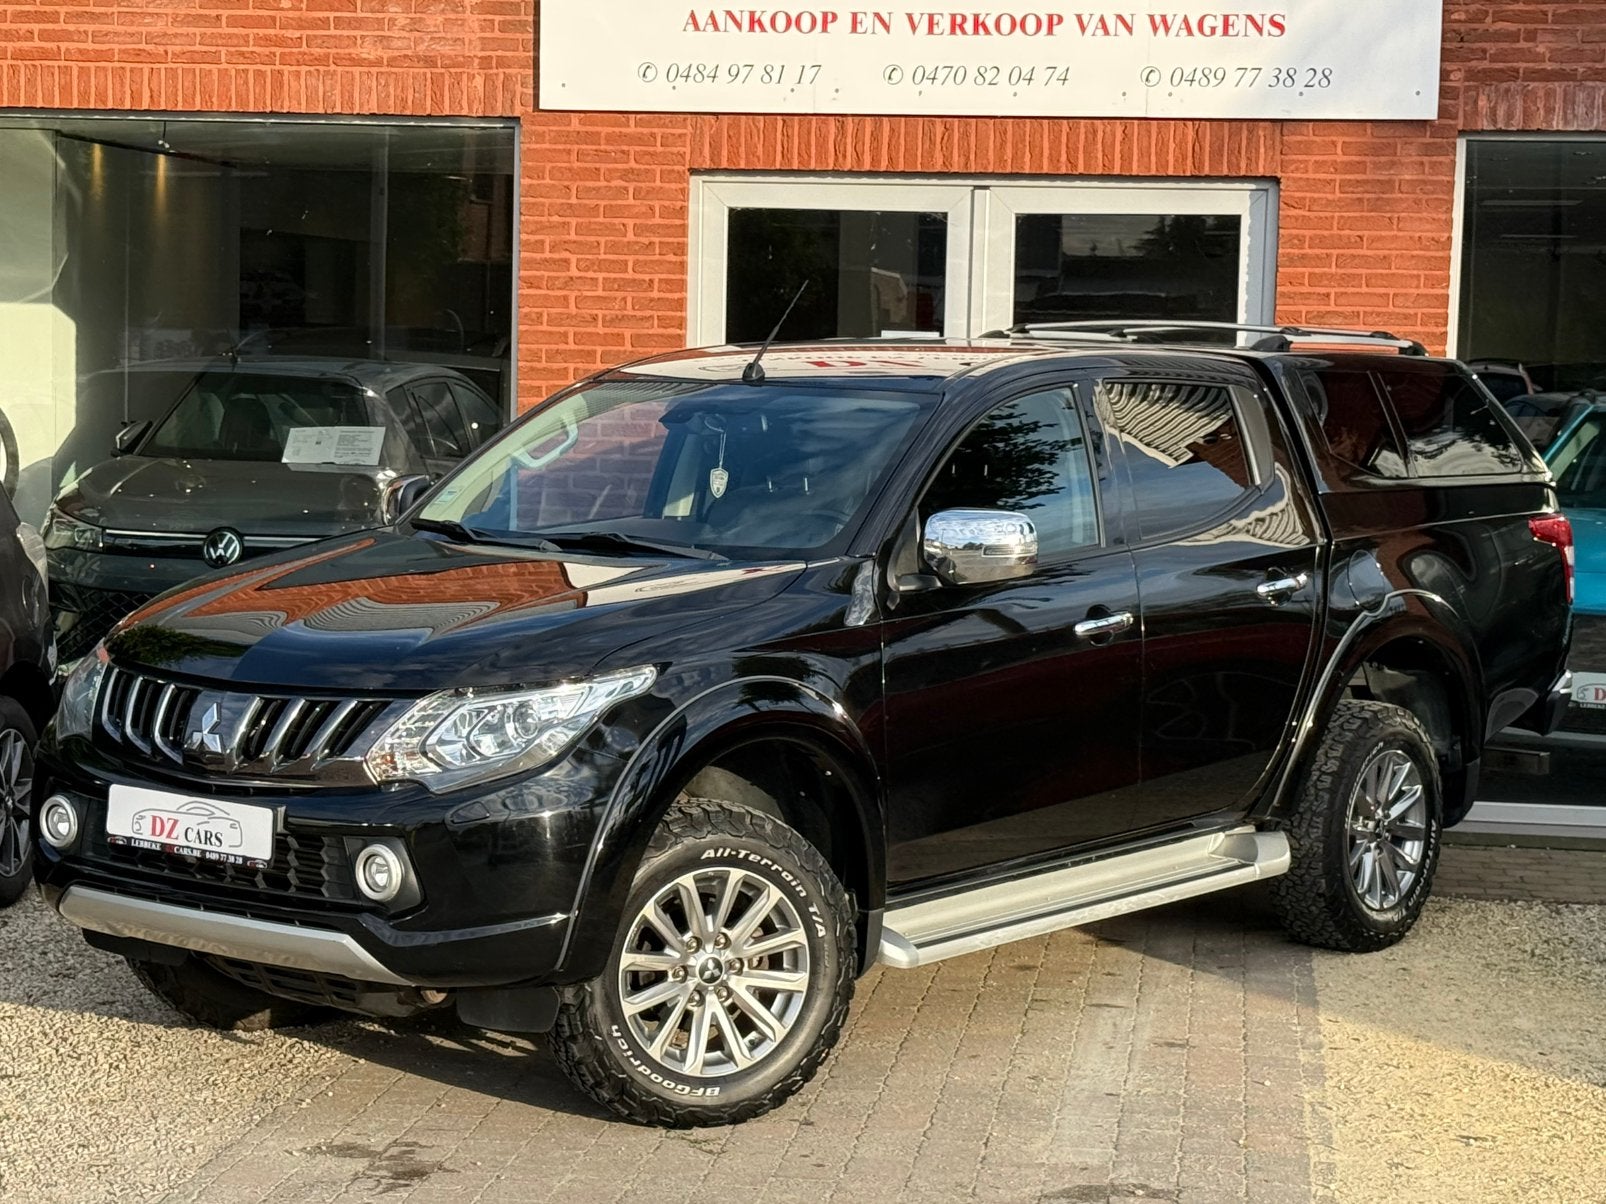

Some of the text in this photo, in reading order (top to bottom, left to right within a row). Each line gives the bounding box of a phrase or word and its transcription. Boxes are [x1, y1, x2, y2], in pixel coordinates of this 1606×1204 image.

[682, 9, 1287, 38] AANKOOP EN VERKOOP VAN WAGENS
[665, 62, 822, 85] 0484 97 81 17
[911, 64, 1070, 87] 0470 82 04 74
[1169, 66, 1333, 87] 0489 77 38 28
[150, 815, 223, 848] DZ CARS
[700, 847, 827, 939] All-Terrain T/A
[611, 1024, 721, 1098] BFGoodrich
